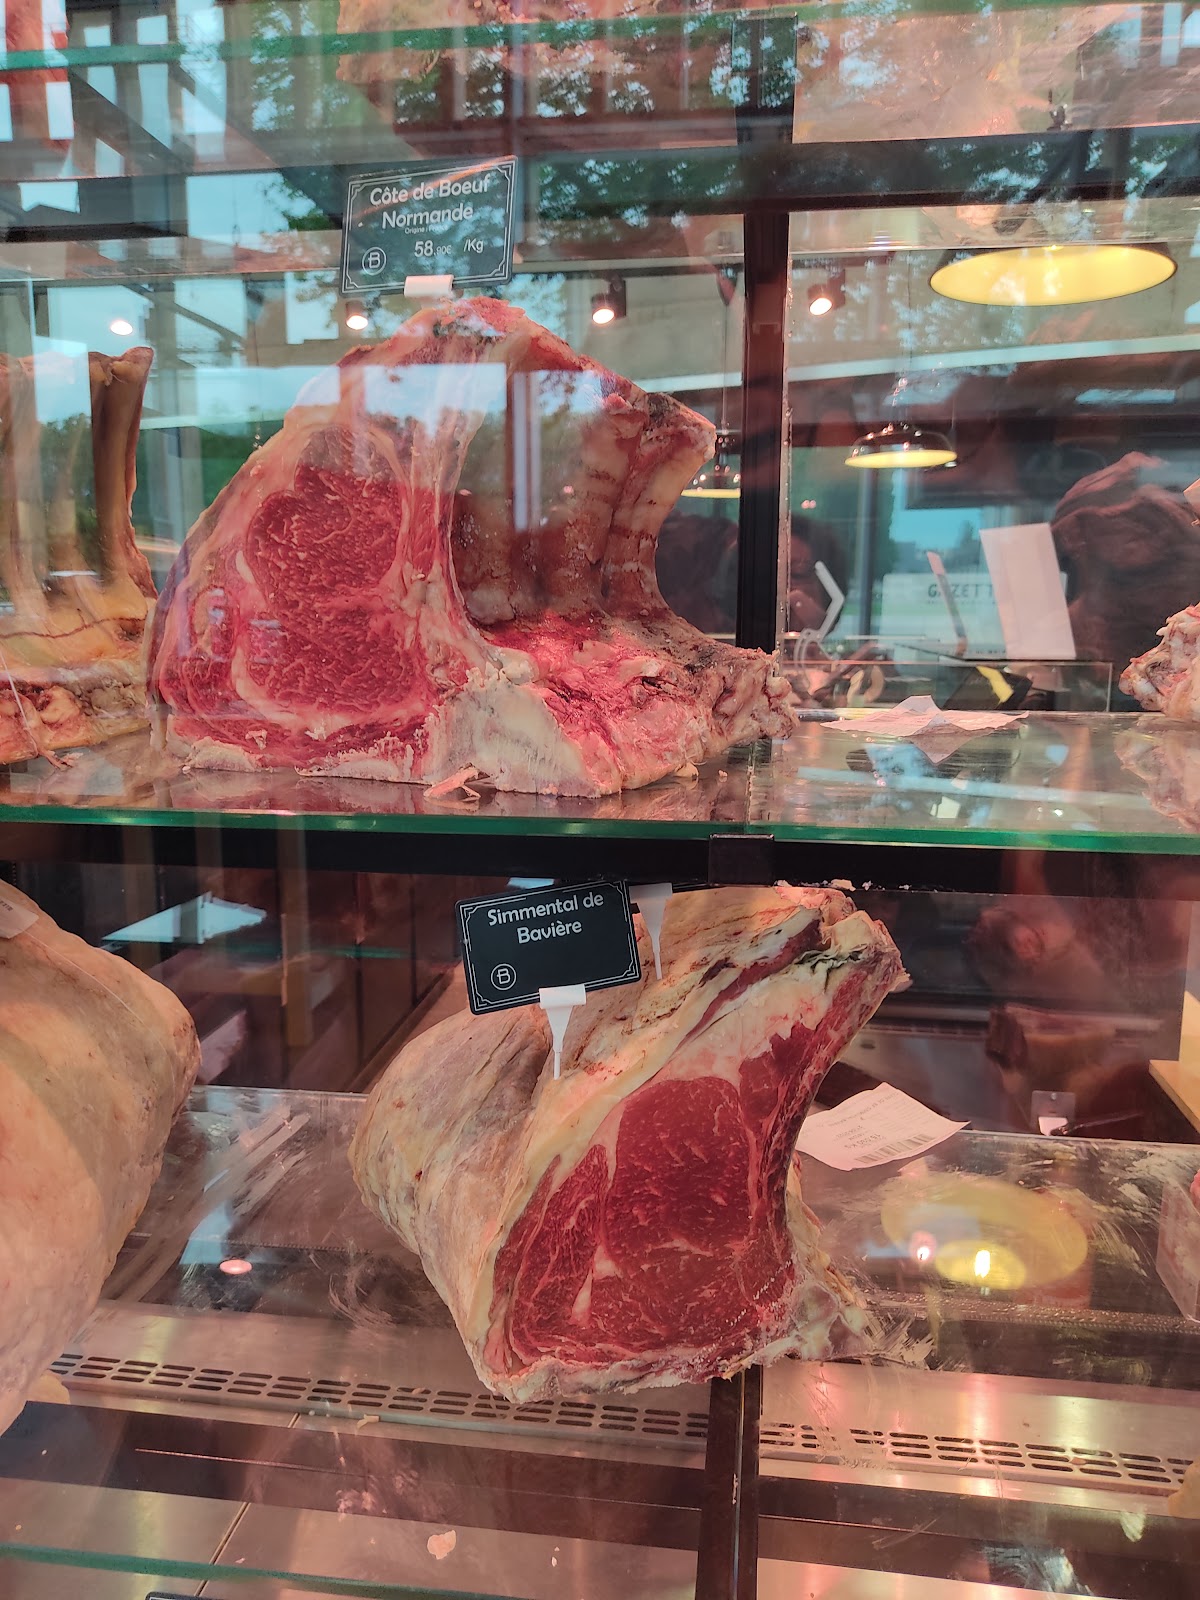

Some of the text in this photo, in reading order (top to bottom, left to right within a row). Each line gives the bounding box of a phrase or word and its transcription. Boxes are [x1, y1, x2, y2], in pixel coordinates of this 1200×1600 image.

[370, 174, 491, 205] Côte de Boeuf
[382, 203, 474, 229] Normande
[405, 226, 425, 235] Origine
[463, 238, 484, 254] /Kg
[928, 583, 994, 598] GZETT
[487, 891, 604, 926] Simmental de
[516, 920, 583, 944] Bavière
